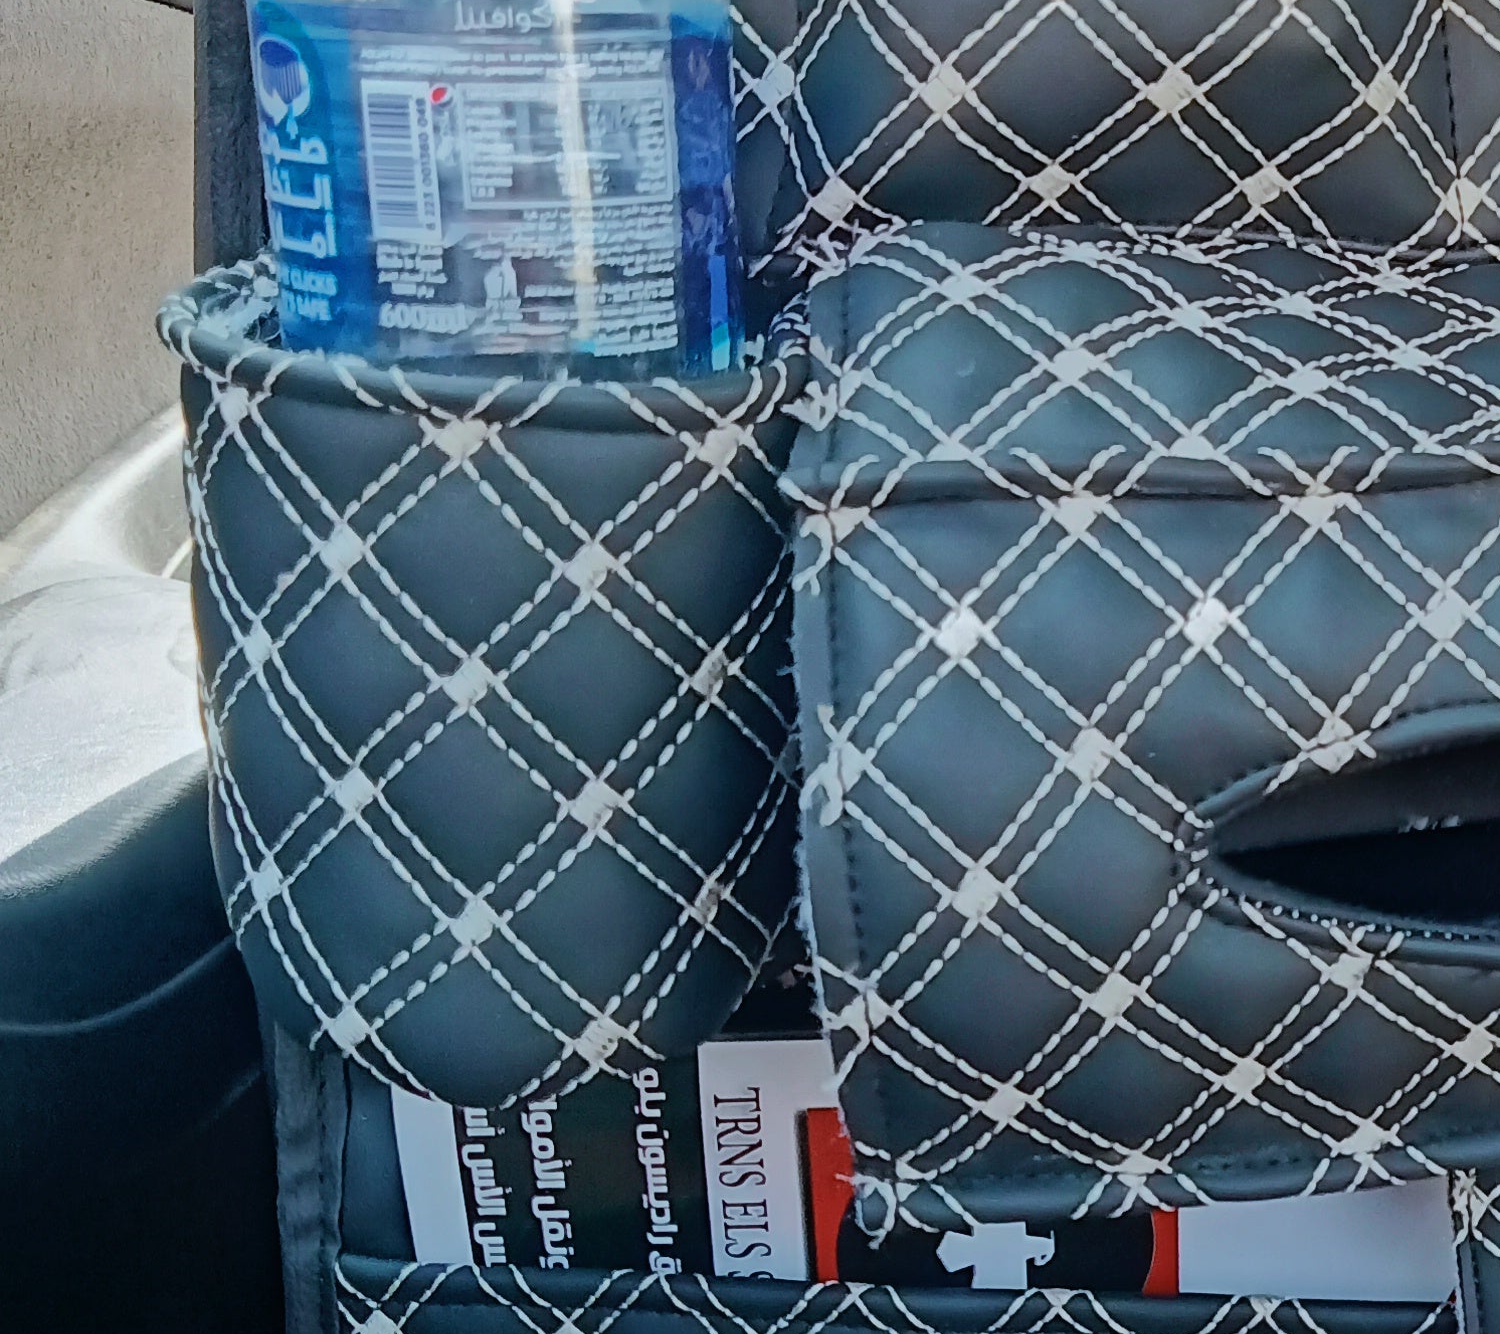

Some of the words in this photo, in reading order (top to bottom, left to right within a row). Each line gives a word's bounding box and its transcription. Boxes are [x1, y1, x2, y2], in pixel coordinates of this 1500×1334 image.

[455, 0, 566, 33] كوافينا
[632, 1067, 666, 1117] بلو
[521, 1097, 573, 1189] الأموا
[713, 1086, 767, 1187] TRNS
[636, 1123, 678, 1245] راديسون
[721, 1199, 772, 1258] ELS
